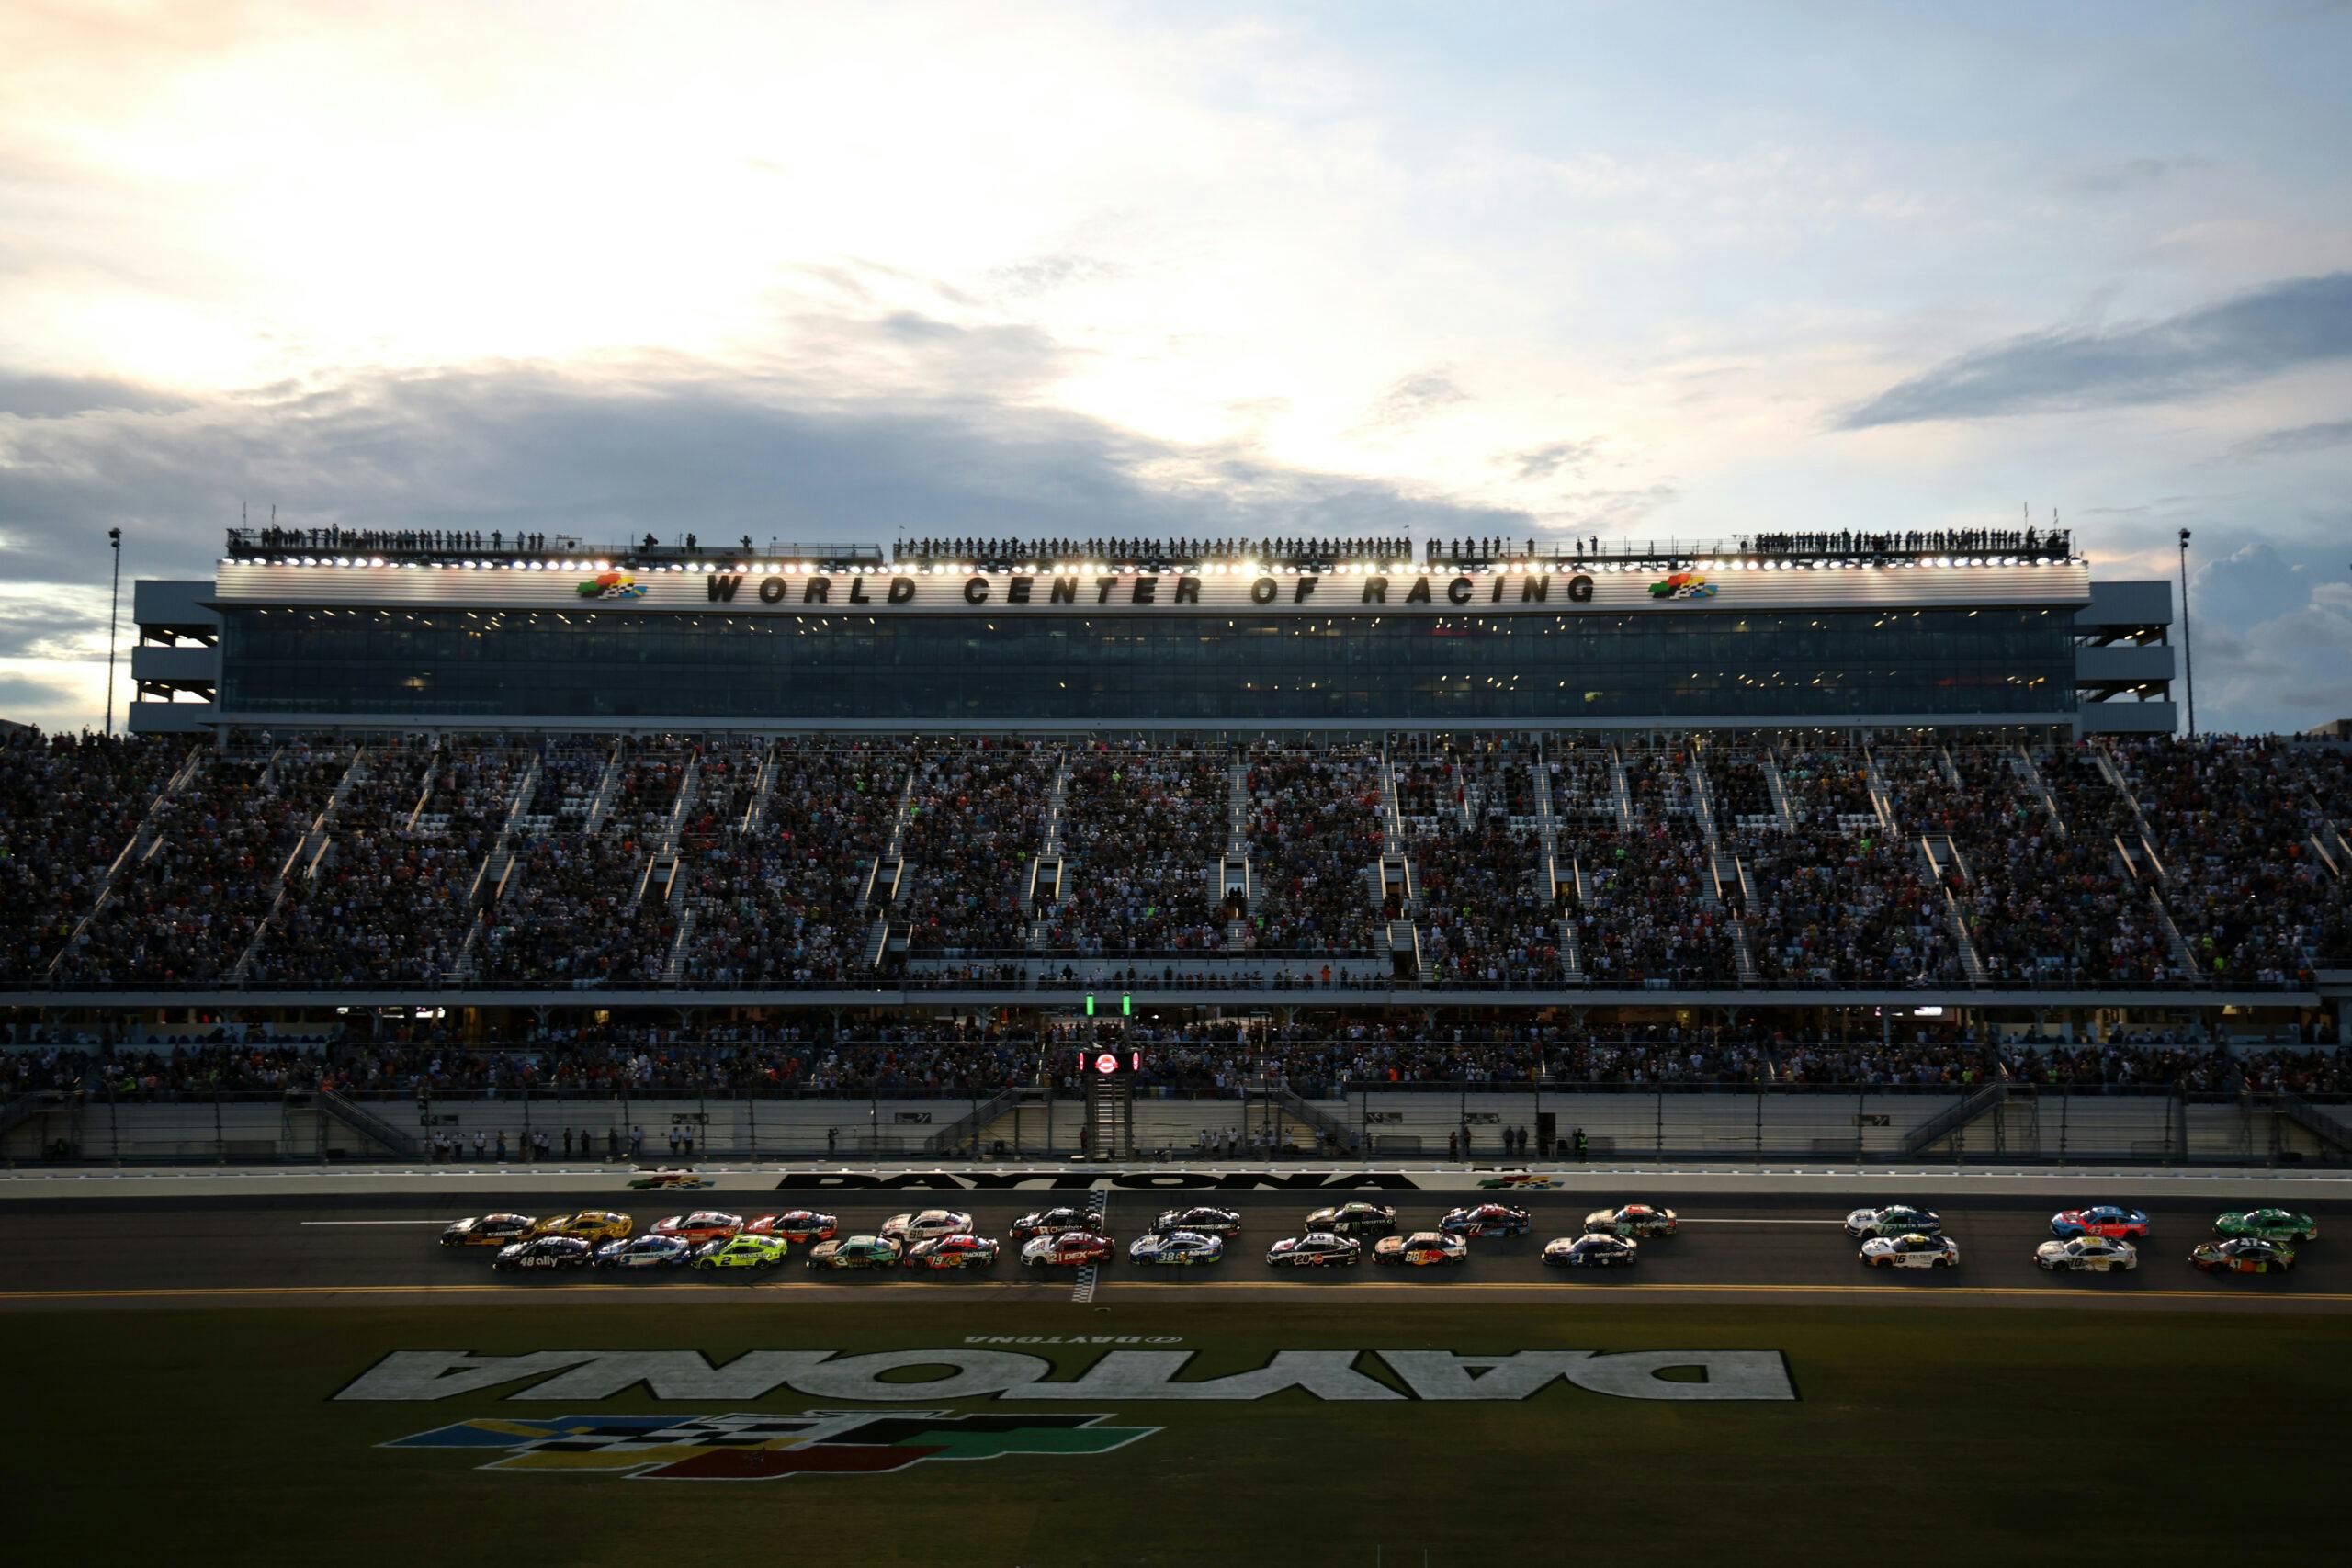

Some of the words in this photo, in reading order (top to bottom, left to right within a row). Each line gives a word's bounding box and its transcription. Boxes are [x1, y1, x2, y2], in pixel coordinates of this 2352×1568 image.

[707, 575, 916, 604] WORLD
[964, 577, 1201, 604] CENTER
[1250, 577, 1318, 604] OF
[1362, 575, 1594, 604] RACING
[776, 1174, 1419, 1190] DAYTONA
[1469, 1224, 1483, 1233] 71
[2088, 1226, 2102, 1235] 43
[2239, 1237, 2258, 1247] 47
[620, 1253, 630, 1264] 5
[1049, 1253, 1062, 1262] 21
[1064, 1250, 1088, 1259] DEX
[1159, 1252, 1174, 1261] 38
[1295, 1255, 1310, 1263] 20
[1405, 1251, 1419, 1262] 88
[1894, 1255, 1906, 1264] 16
[519, 1257, 535, 1267] 48
[536, 1255, 558, 1268] ally
[720, 1257, 732, 1265] 2
[834, 1256, 848, 1266] 3
[932, 1256, 944, 1265] 19
[2229, 1258, 2242, 1269] 47
[334, 1350, 1799, 1401] DAYTONA
